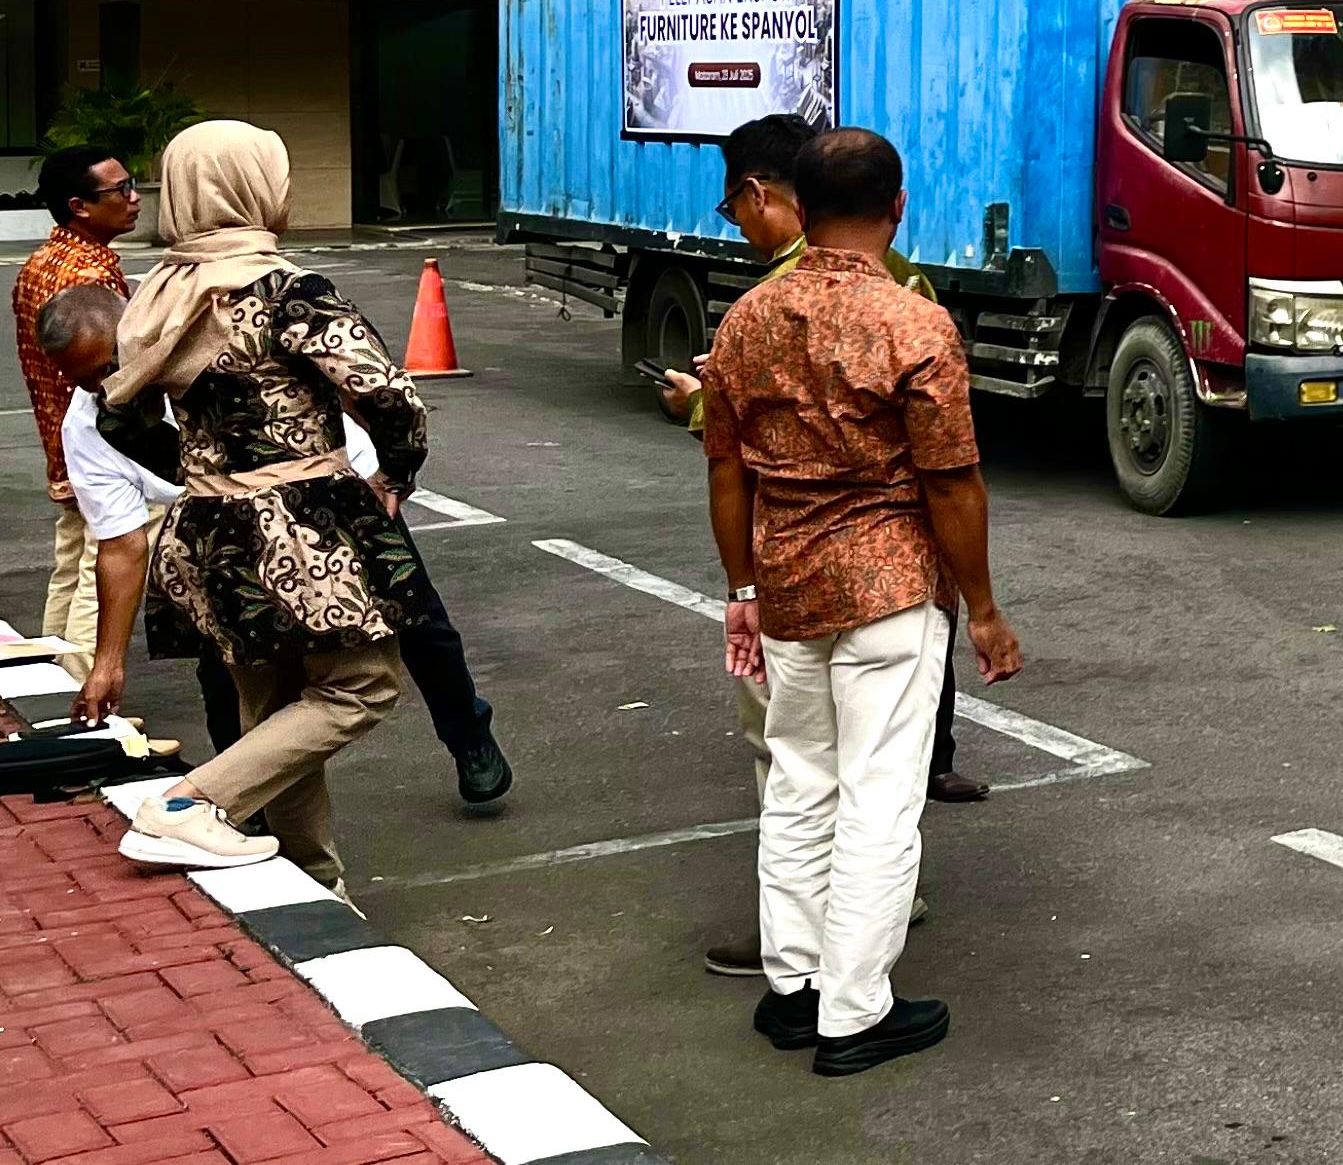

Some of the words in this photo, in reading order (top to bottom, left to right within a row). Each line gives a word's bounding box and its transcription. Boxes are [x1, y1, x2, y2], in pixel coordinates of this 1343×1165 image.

[640, 13, 717, 41] FURNITURE
[720, 12, 738, 40] KE
[742, 10, 818, 40] SPANYOL
